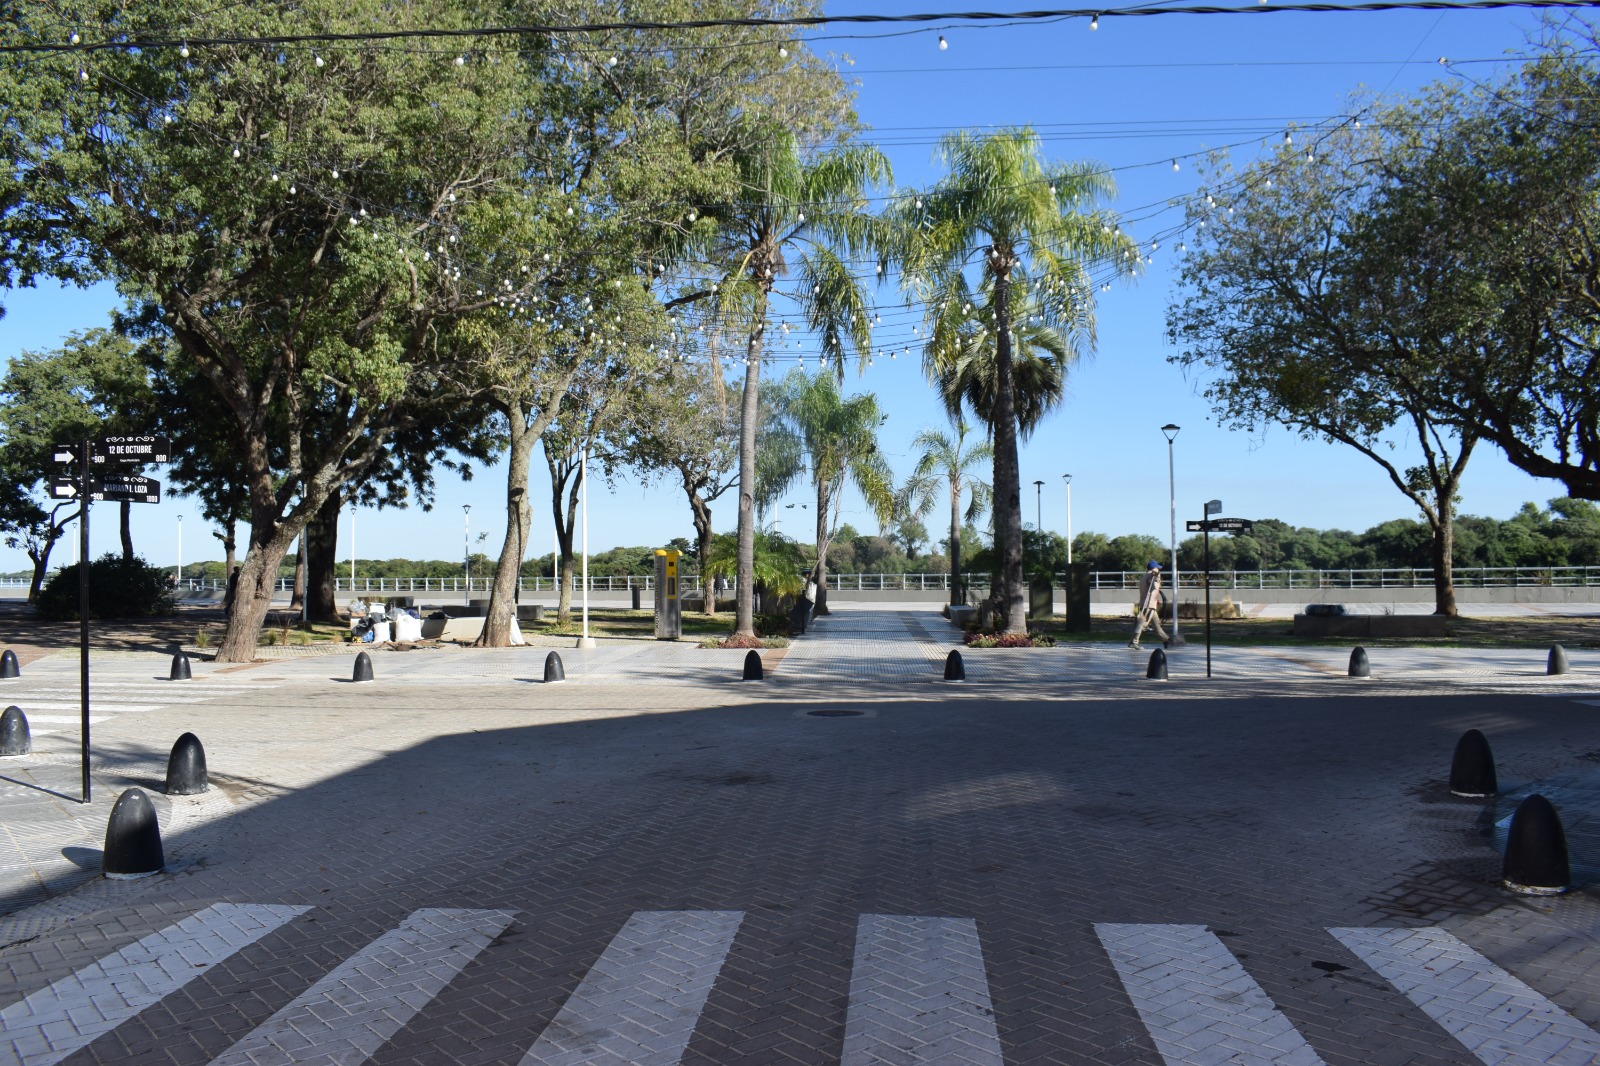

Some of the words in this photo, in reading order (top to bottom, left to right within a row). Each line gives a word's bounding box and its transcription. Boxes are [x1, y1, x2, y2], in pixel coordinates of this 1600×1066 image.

[108, 446, 116, 454] 12
[116, 446, 124, 454] DE
[126, 445, 152, 454] OCTUBRE
[104, 484, 128, 492] MARIANO
